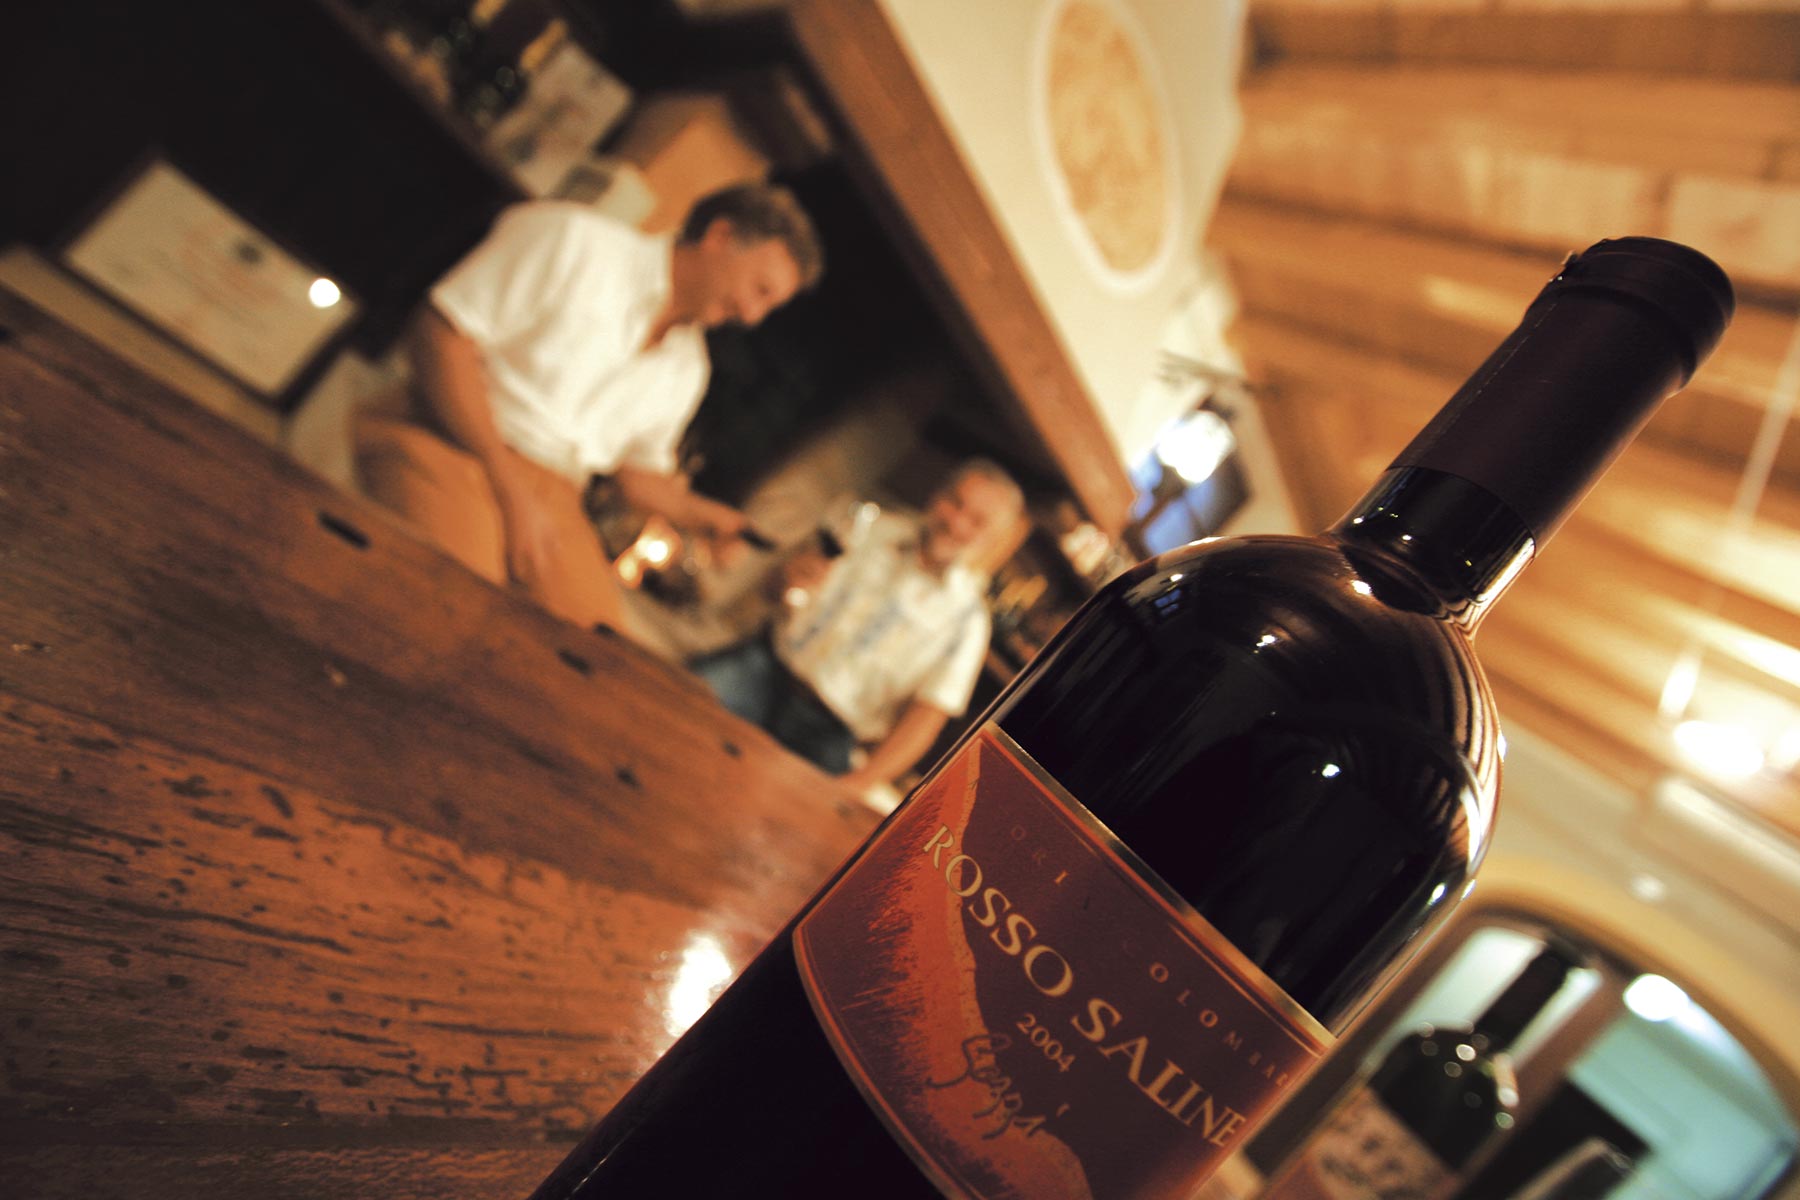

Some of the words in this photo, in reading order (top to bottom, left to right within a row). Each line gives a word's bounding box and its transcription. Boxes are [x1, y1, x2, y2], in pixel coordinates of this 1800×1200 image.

[924, 826, 1073, 997] ROSSO
[1073, 999, 1246, 1147] SALINE
[1016, 1013, 1077, 1072] 2004
